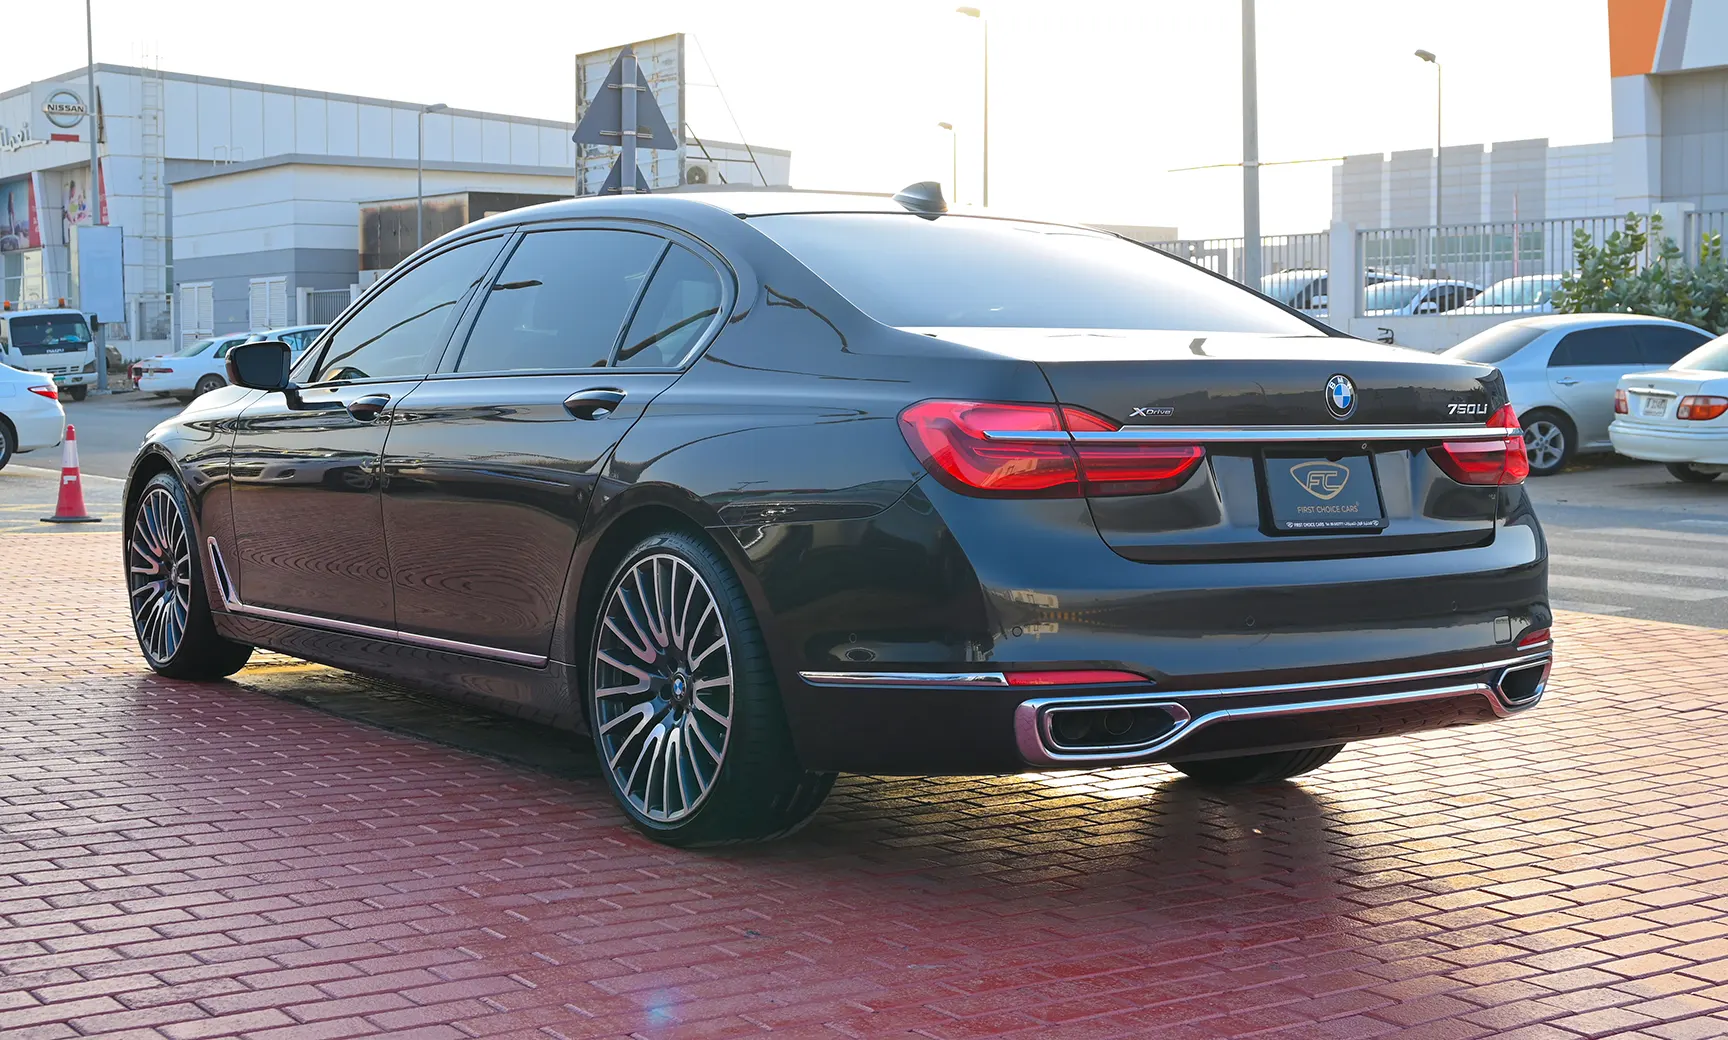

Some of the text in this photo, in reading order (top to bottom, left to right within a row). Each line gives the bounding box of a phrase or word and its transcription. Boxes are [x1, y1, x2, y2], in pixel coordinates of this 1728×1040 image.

[47, 104, 84, 112] NISSAN
[1328, 376, 1354, 396] BMW
[1297, 505, 1359, 514] FIRST CHOICE CARS
